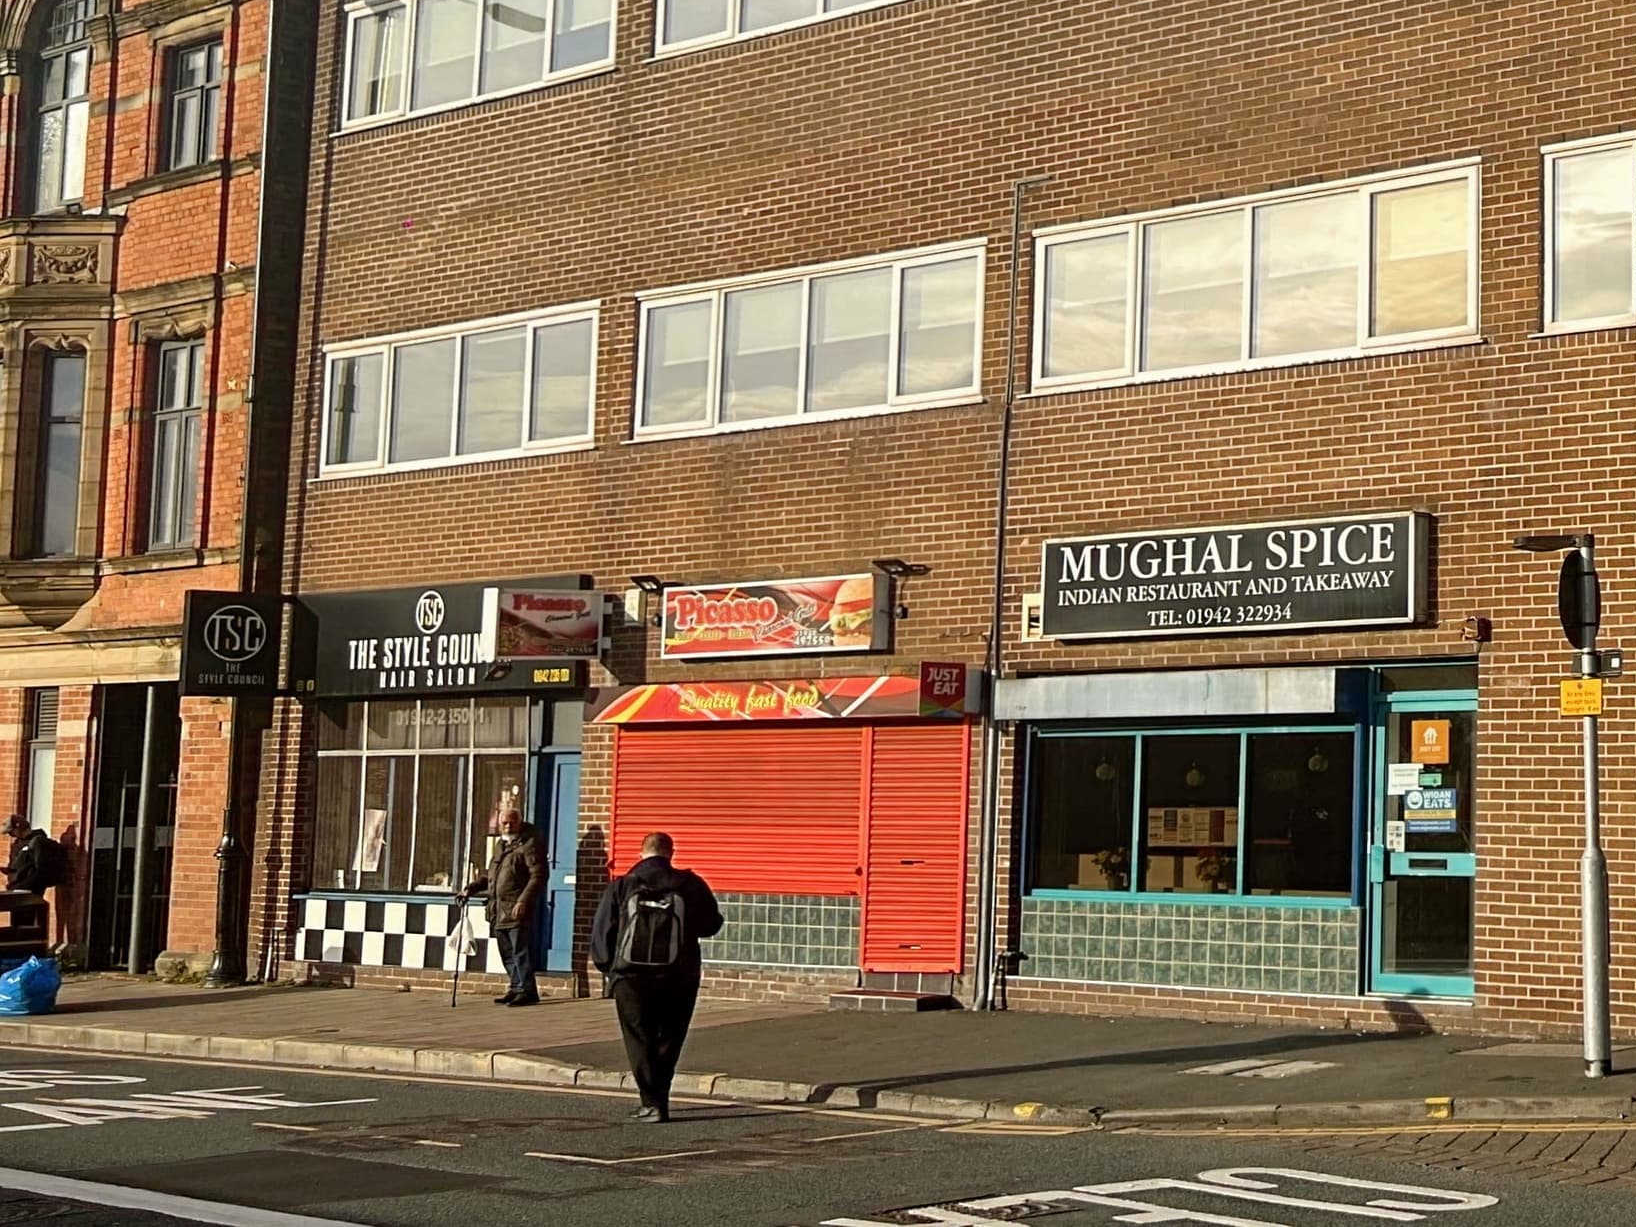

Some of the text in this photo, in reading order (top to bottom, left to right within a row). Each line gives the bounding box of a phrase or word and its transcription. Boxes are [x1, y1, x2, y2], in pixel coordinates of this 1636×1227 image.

[1058, 523, 1396, 584] MUGHAL SPICE
[1057, 570, 1395, 607] INDIAN RESTAURANT AND TAKEAWAY
[674, 594, 778, 630] Picasso
[1147, 602, 1292, 627] TEL: 01942 322934
[349, 639, 378, 670] THE
[383, 636, 431, 669] STYLE
[198, 674, 224, 684] STYLE
[379, 667, 476, 688] HAIR SALON
[927, 667, 959, 682] JUST
[679, 683, 821, 715] Quality fast food
[933, 681, 959, 696] EAT
[1423, 791, 1452, 799] WIGAN
[1424, 799, 1452, 809] EATS
